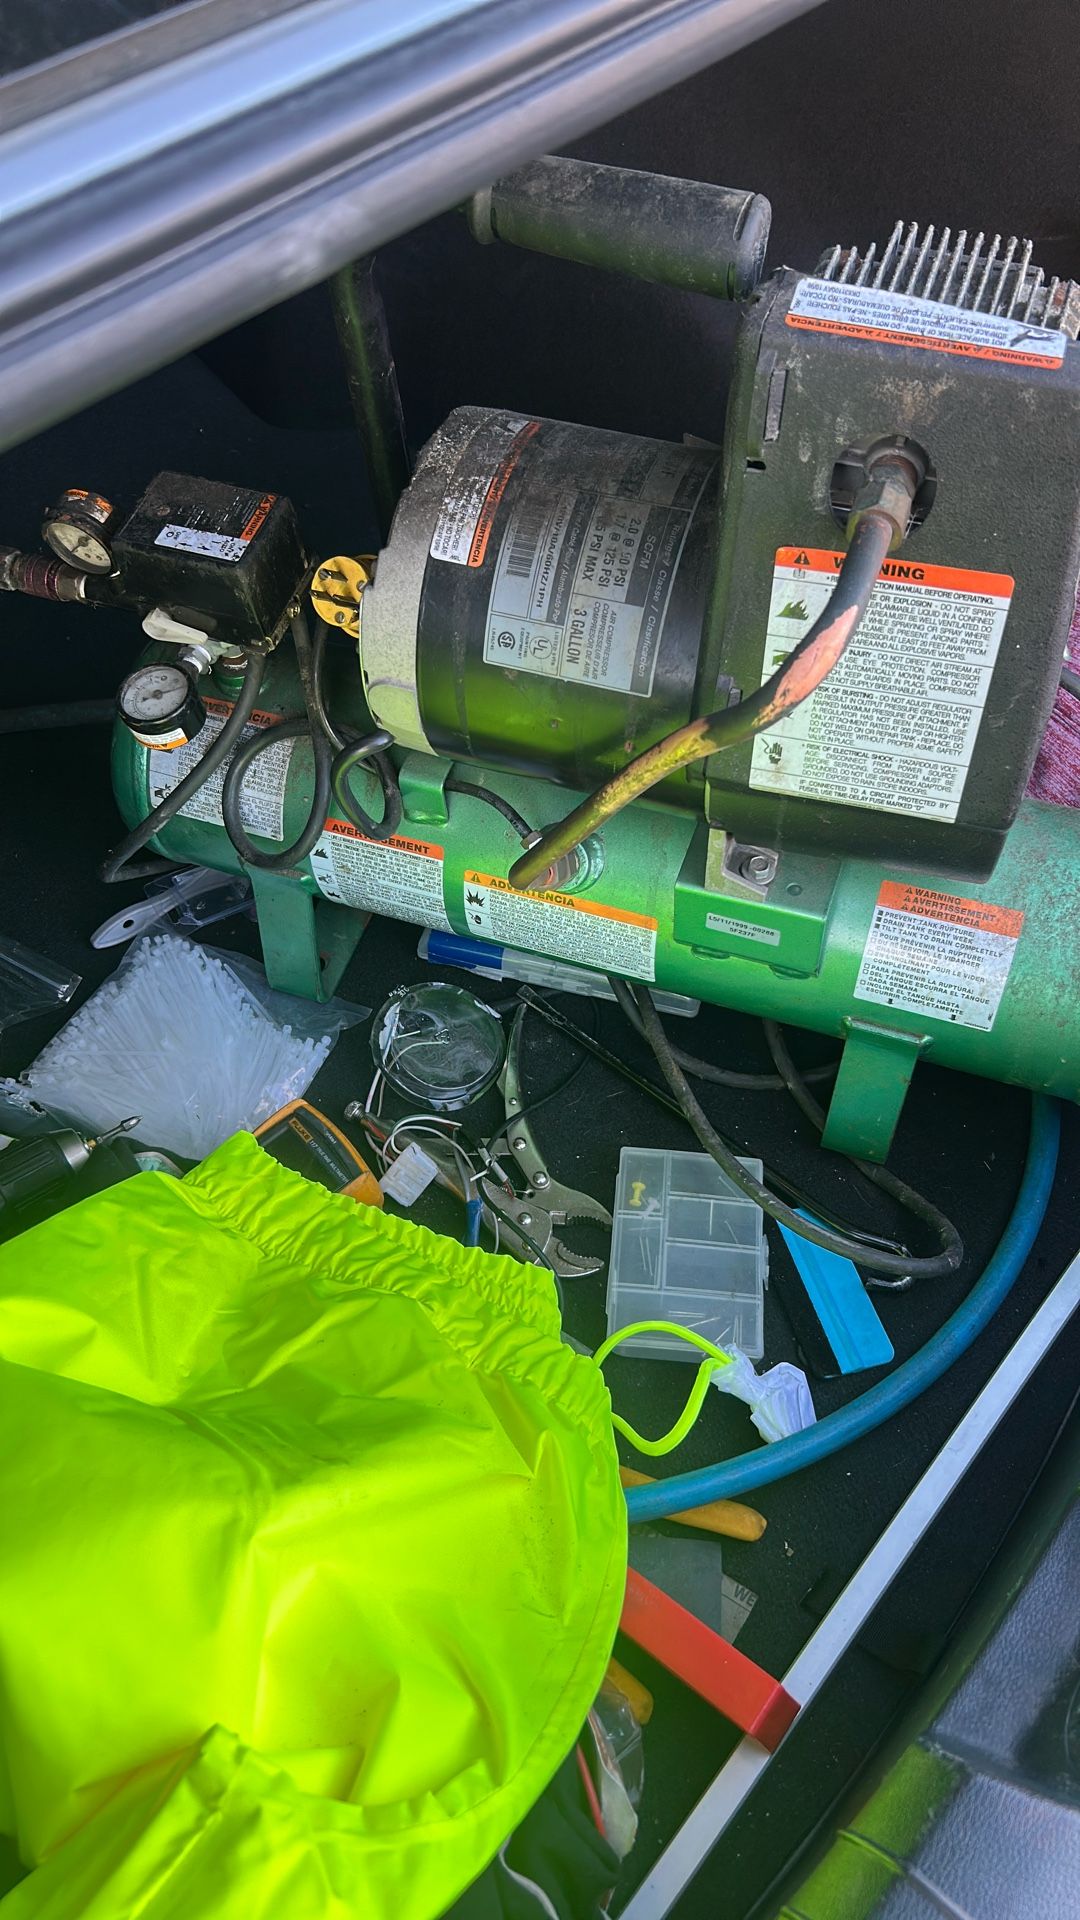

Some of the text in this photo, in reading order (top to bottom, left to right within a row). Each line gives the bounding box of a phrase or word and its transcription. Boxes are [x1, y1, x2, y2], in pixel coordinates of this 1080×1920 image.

[790, 316, 863, 334] ADVERTENCIA
[875, 319, 889, 327] NOT
[627, 518, 641, 533] 2.0
[588, 534, 603, 551] PSI
[597, 512, 627, 587] 1.7 @ 125 PSI
[621, 538, 635, 547] @
[638, 534, 656, 568] SCFM
[662, 524, 680, 555] Ratings
[581, 555, 598, 581] MAX
[612, 568, 628, 586] PSI
[832, 557, 925, 580] WNING
[553, 568, 569, 607] Alambrado
[651, 570, 667, 601] Classe
[894, 584, 993, 604] MANUAL BEFORE OPERATING.
[551, 606, 560, 622] Por
[892, 597, 932, 608] EXPLOSION
[939, 603, 951, 611] DO
[953, 605, 969, 613] NOT
[971, 607, 996, 617] SPRAY
[565, 608, 587, 664] 3 GALLON
[581, 601, 601, 679] COMPRESOR DE AIRE
[868, 617, 990, 640] WHILE SPRAYING OR SPRAY WHERE
[590, 602, 609, 679] COMPRESSEUR D'AIR
[600, 610, 617, 676] AIR COMPRESSOR
[848, 649, 982, 675] INJURY DO NOT DIRECT AIR STREAM AT
[815, 685, 830, 693] RISK
[841, 689, 874, 699] BURSTING
[878, 694, 889, 702] DO
[890, 696, 905, 704] NOT
[906, 699, 929, 708] ADJUST
[928, 702, 972, 715] REGULATOR
[832, 747, 870, 759] ELECTRICAL
[871, 753, 893, 762] SHOCK
[808, 780, 846, 792] CONNECTED
[869, 791, 894, 800] CIRCUIT
[897, 795, 936, 807] PROTECTED
[820, 788, 832, 796] USE
[833, 791, 868, 802] TIME-DELAY
[885, 799, 912, 809] MARKED
[914, 888, 962, 905] WARNING
[884, 911, 916, 924] PREVENT
[918, 919, 937, 929] TANK
[909, 904, 981, 927] ADVERTENCIA
[911, 896, 996, 922] AVERTISSEMENT
[878, 932, 898, 941] POUR
[880, 924, 896, 933] TILT
[897, 928, 917, 938] TANK
[930, 936, 953, 946] DRAIN
[954, 942, 1003, 958] COMPLETELY
[882, 918, 973, 944] DRAIN TANK EVERY WEEK
[943, 954, 980, 968] VIDANGER
[867, 975, 918, 992] CADA SEMANA
[870, 964, 889, 973] PARA
[890, 969, 925, 982] PREVENIR
[930, 965, 950, 974] POUR
[963, 973, 985, 983] VIDER
[866, 981, 894, 992] INCLINE
[906, 991, 935, 1002] TANQUE
[936, 998, 960, 1008] HASTA
[869, 970, 883, 978] DEL
[884, 974, 913, 986] TANQUE
[914, 981, 948, 994] ESCURRA
[961, 993, 990, 1004] TANQUE
[865, 986, 964, 1015] ESCURRIR COMPLETAMENTE
[734, 1583, 757, 1607] WE
